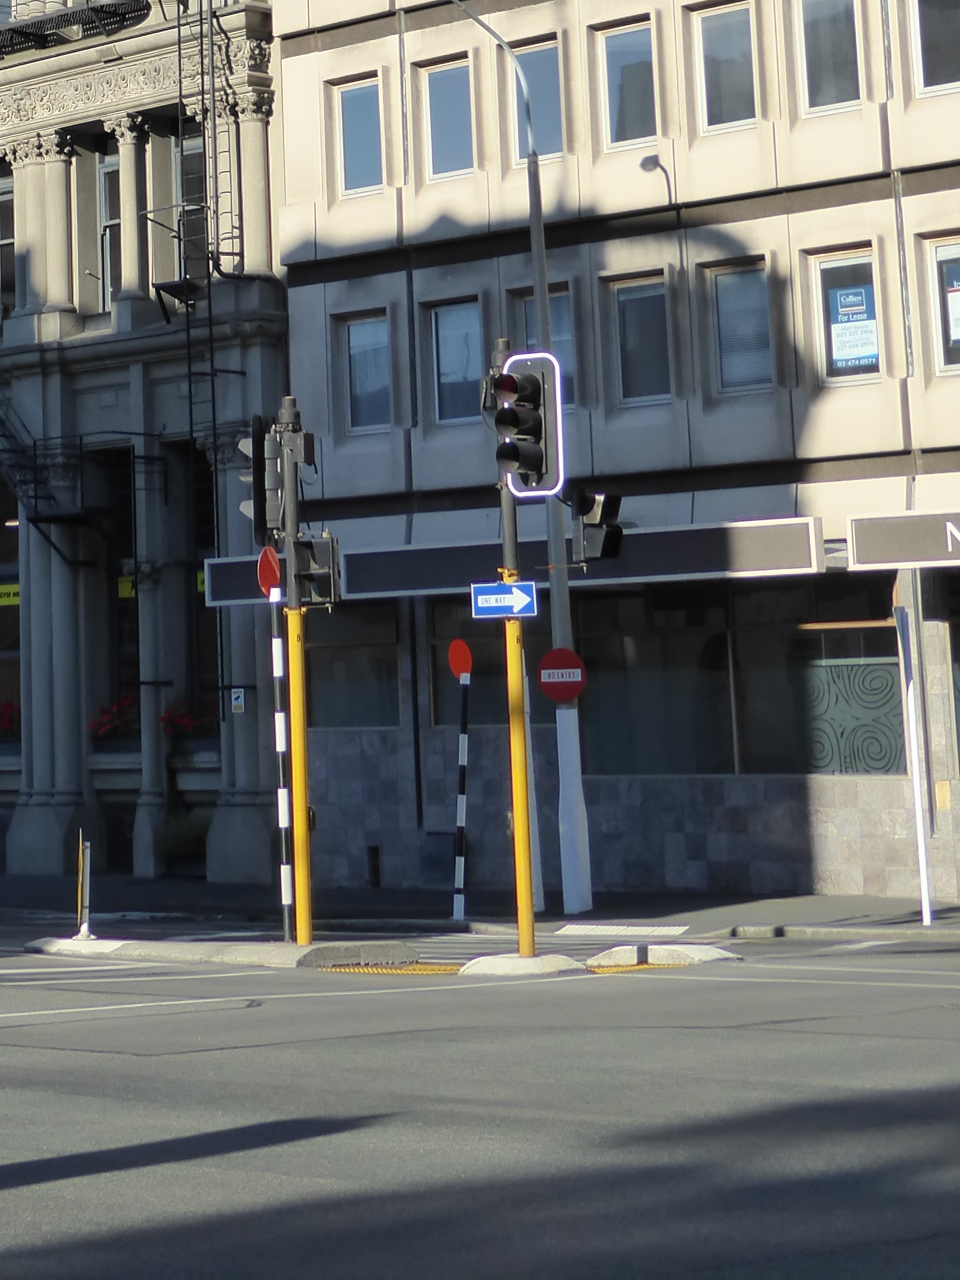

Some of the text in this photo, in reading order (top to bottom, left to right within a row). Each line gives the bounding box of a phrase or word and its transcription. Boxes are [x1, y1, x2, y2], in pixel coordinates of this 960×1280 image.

[838, 313, 868, 322] For Lease
[0, 591, 12, 599] GYM
[480, 596, 506, 605] ONE WAY
[547, 671, 576, 680] NO ENTRY
